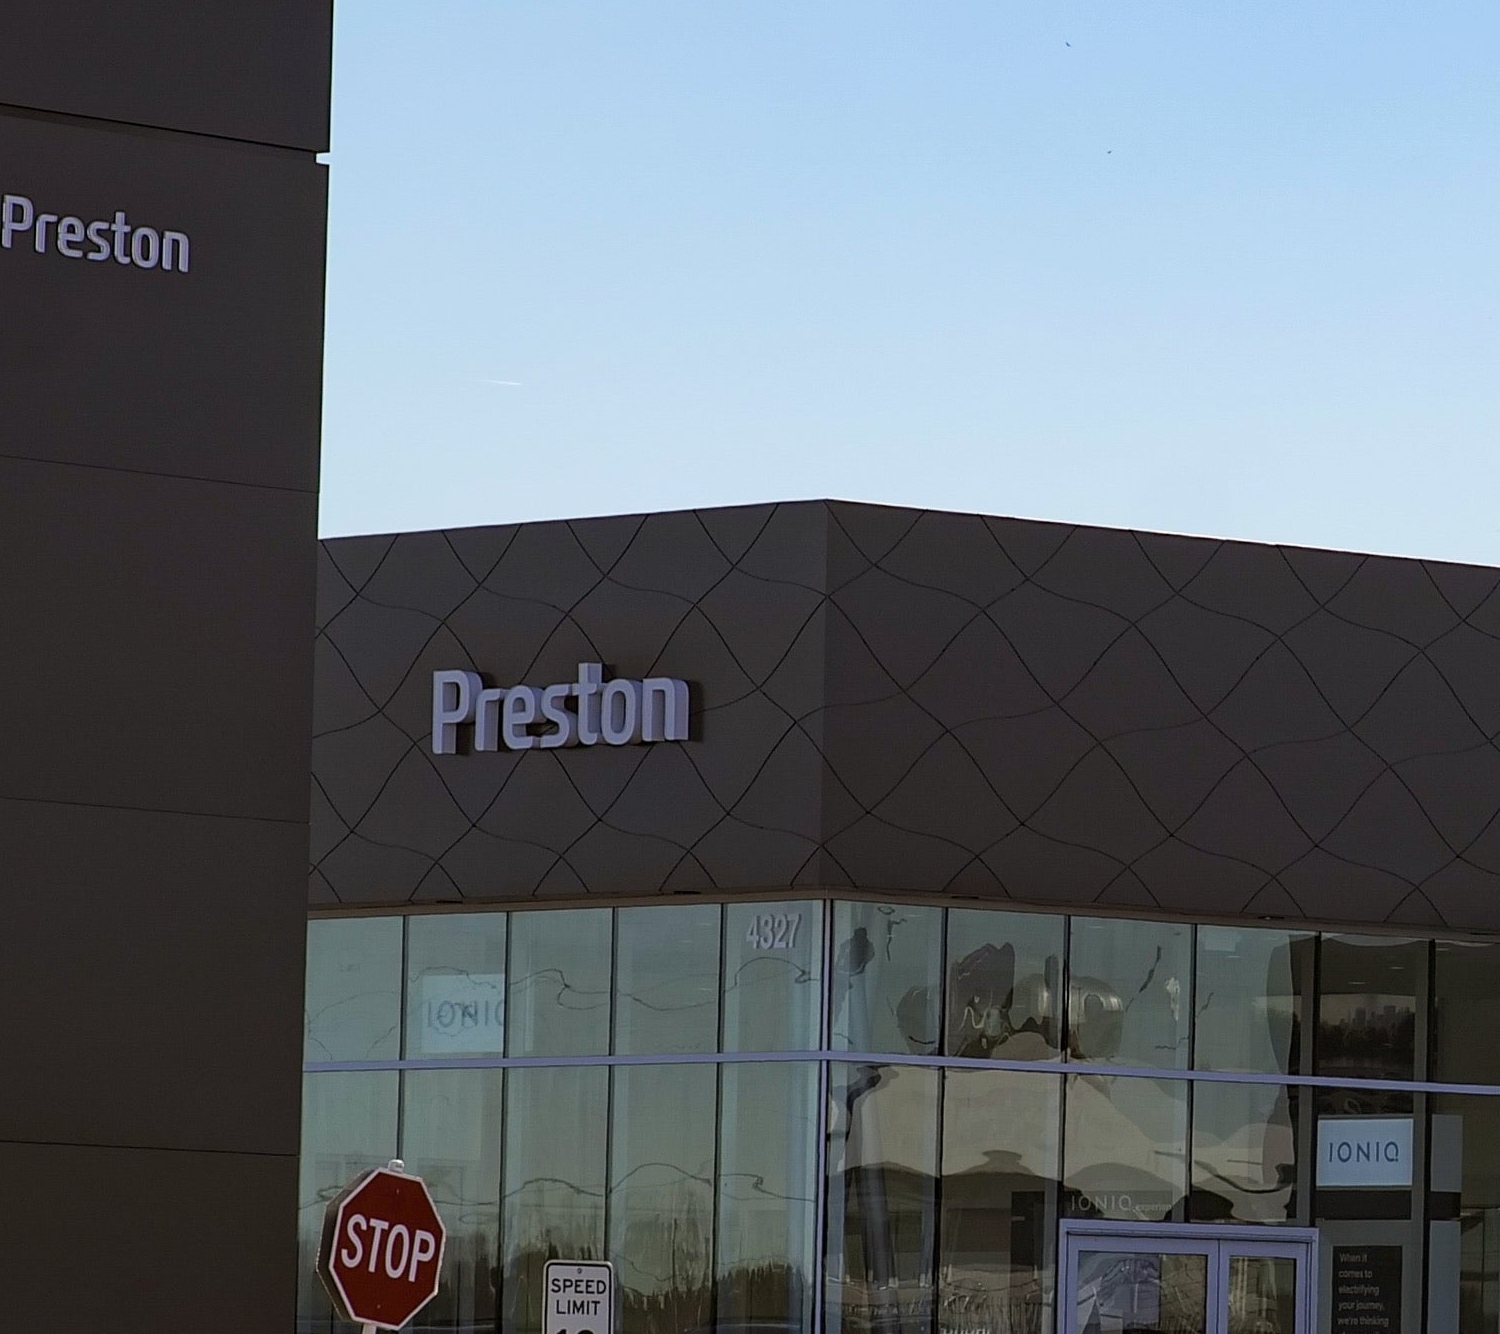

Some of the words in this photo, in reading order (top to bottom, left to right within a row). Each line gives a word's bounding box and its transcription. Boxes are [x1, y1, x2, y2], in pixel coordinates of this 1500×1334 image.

[1, 193, 189, 273] Preston
[432, 662, 690, 754] Preston
[746, 913, 802, 949] 4327
[1329, 1141, 1399, 1163] IONIQ
[1071, 1194, 1134, 1212] IONIQ
[340, 1213, 437, 1283] STOP
[1364, 1269, 1373, 1278] to
[551, 1278, 607, 1295] SPEED
[556, 1299, 601, 1316] LIMIT
